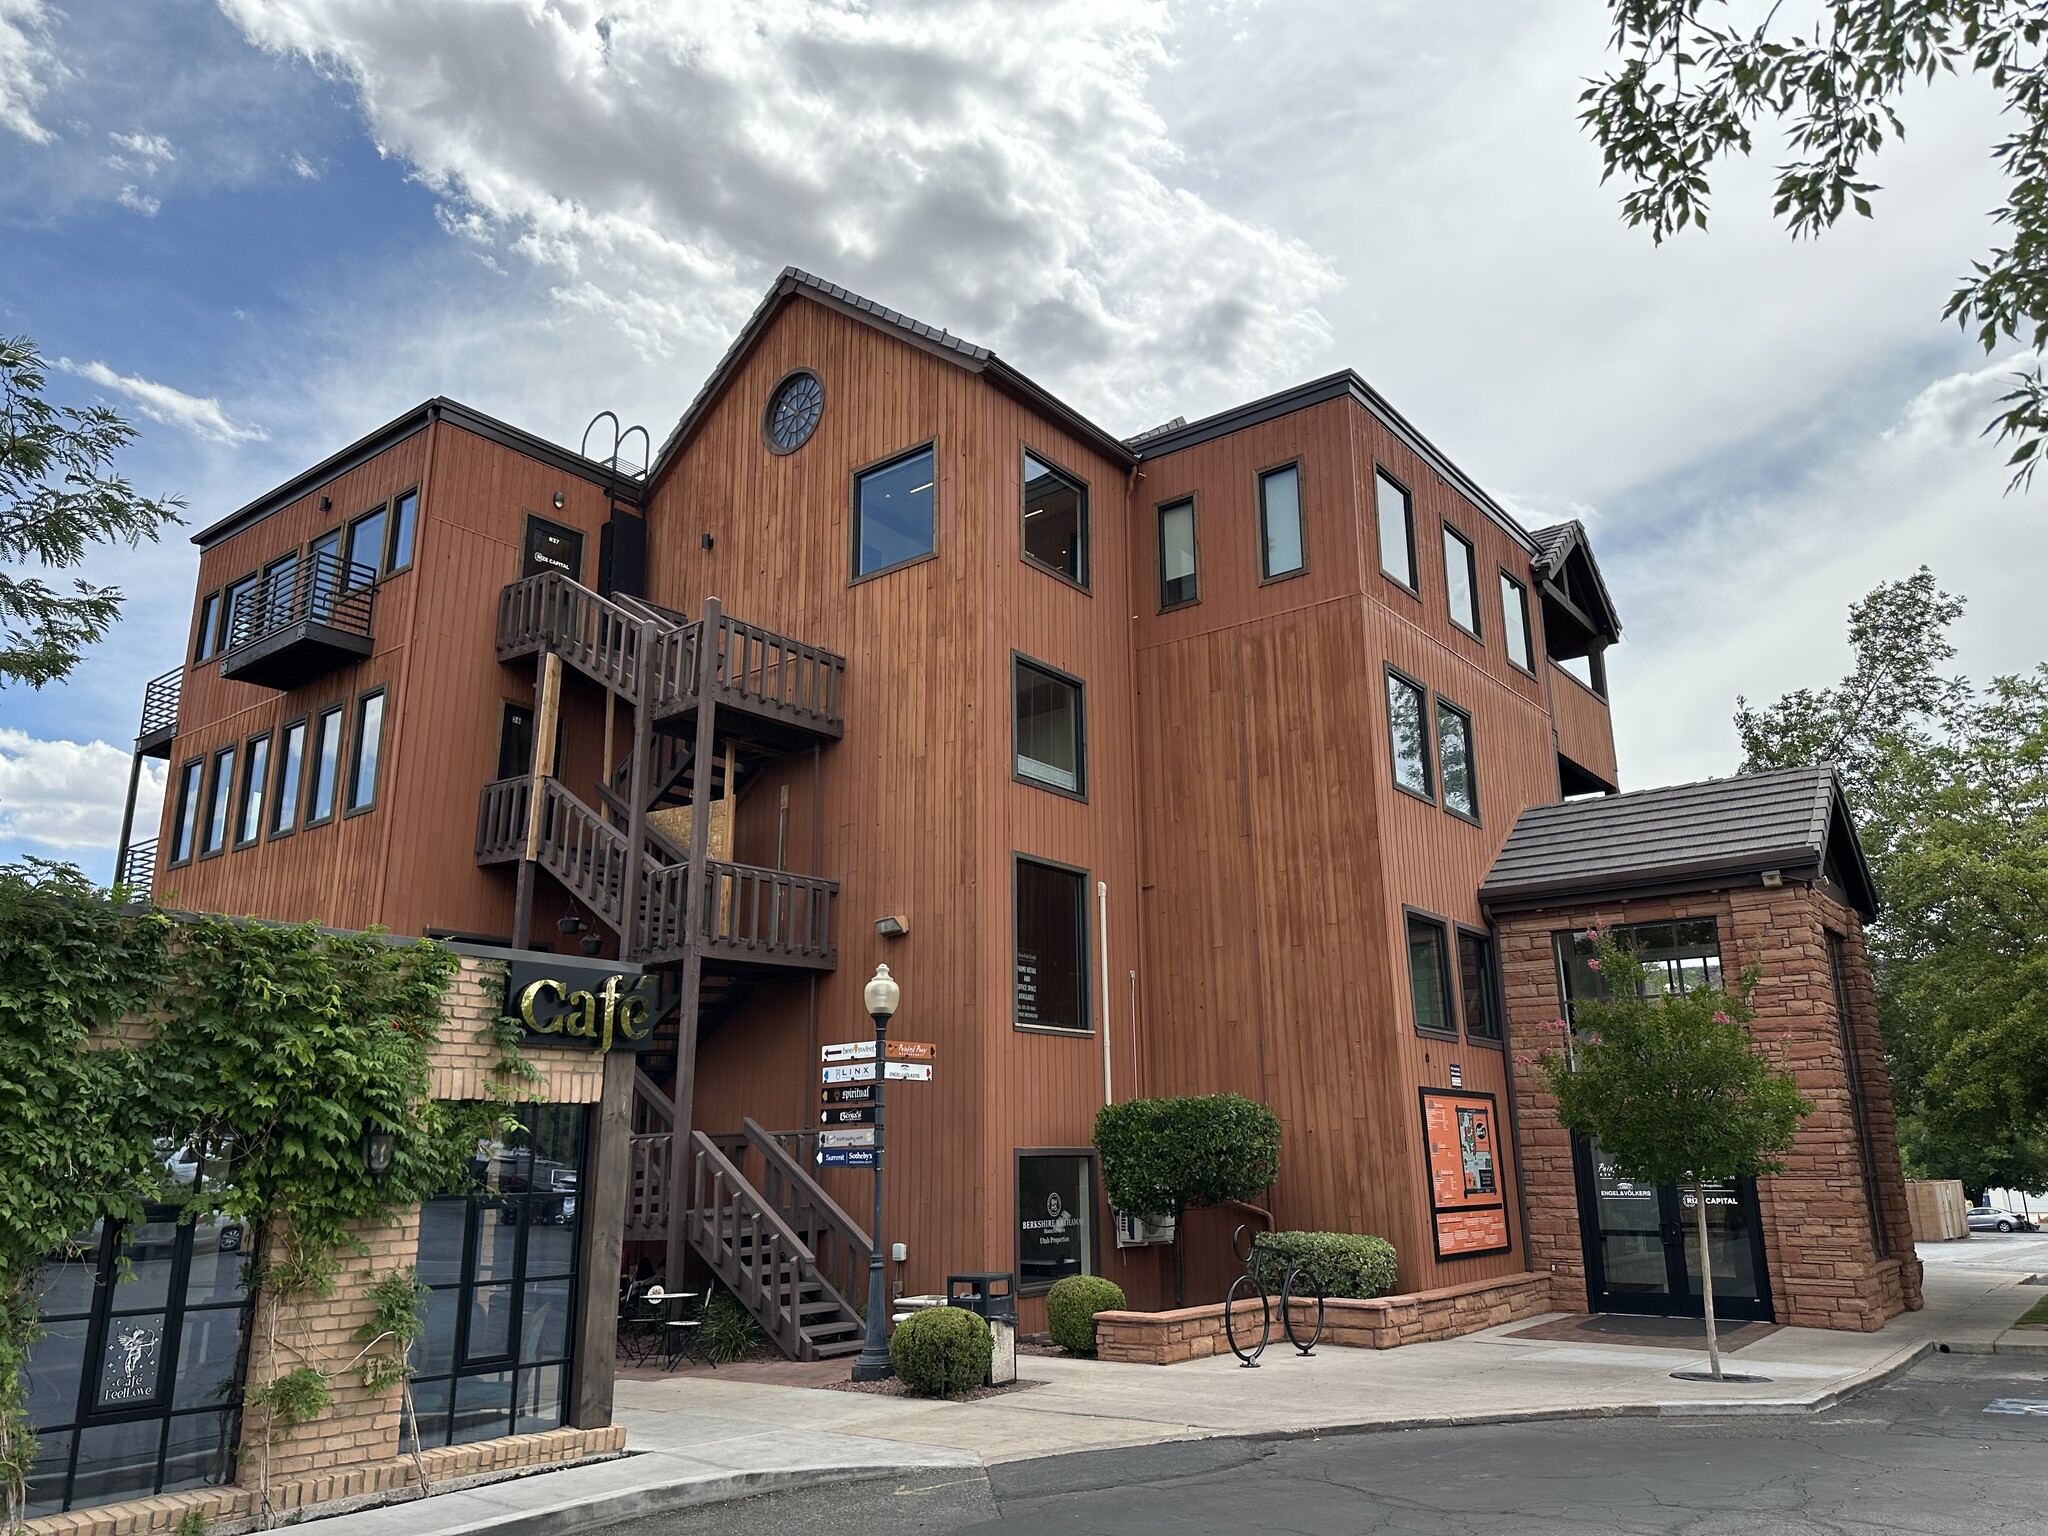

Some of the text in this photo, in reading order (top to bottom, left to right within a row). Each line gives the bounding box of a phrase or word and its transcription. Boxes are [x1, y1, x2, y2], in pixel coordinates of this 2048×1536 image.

[549, 558, 570, 570] CAPITAL
[520, 974, 659, 1055] Café
[842, 1067, 869, 1076] LINX
[842, 1086, 870, 1101] spiritual
[849, 1152, 873, 1161] Sotheby's
[1022, 1220, 1056, 1230] BERKSHIRE
[116, 1373, 144, 1388] Café
[105, 1386, 152, 1400] FeelLove
